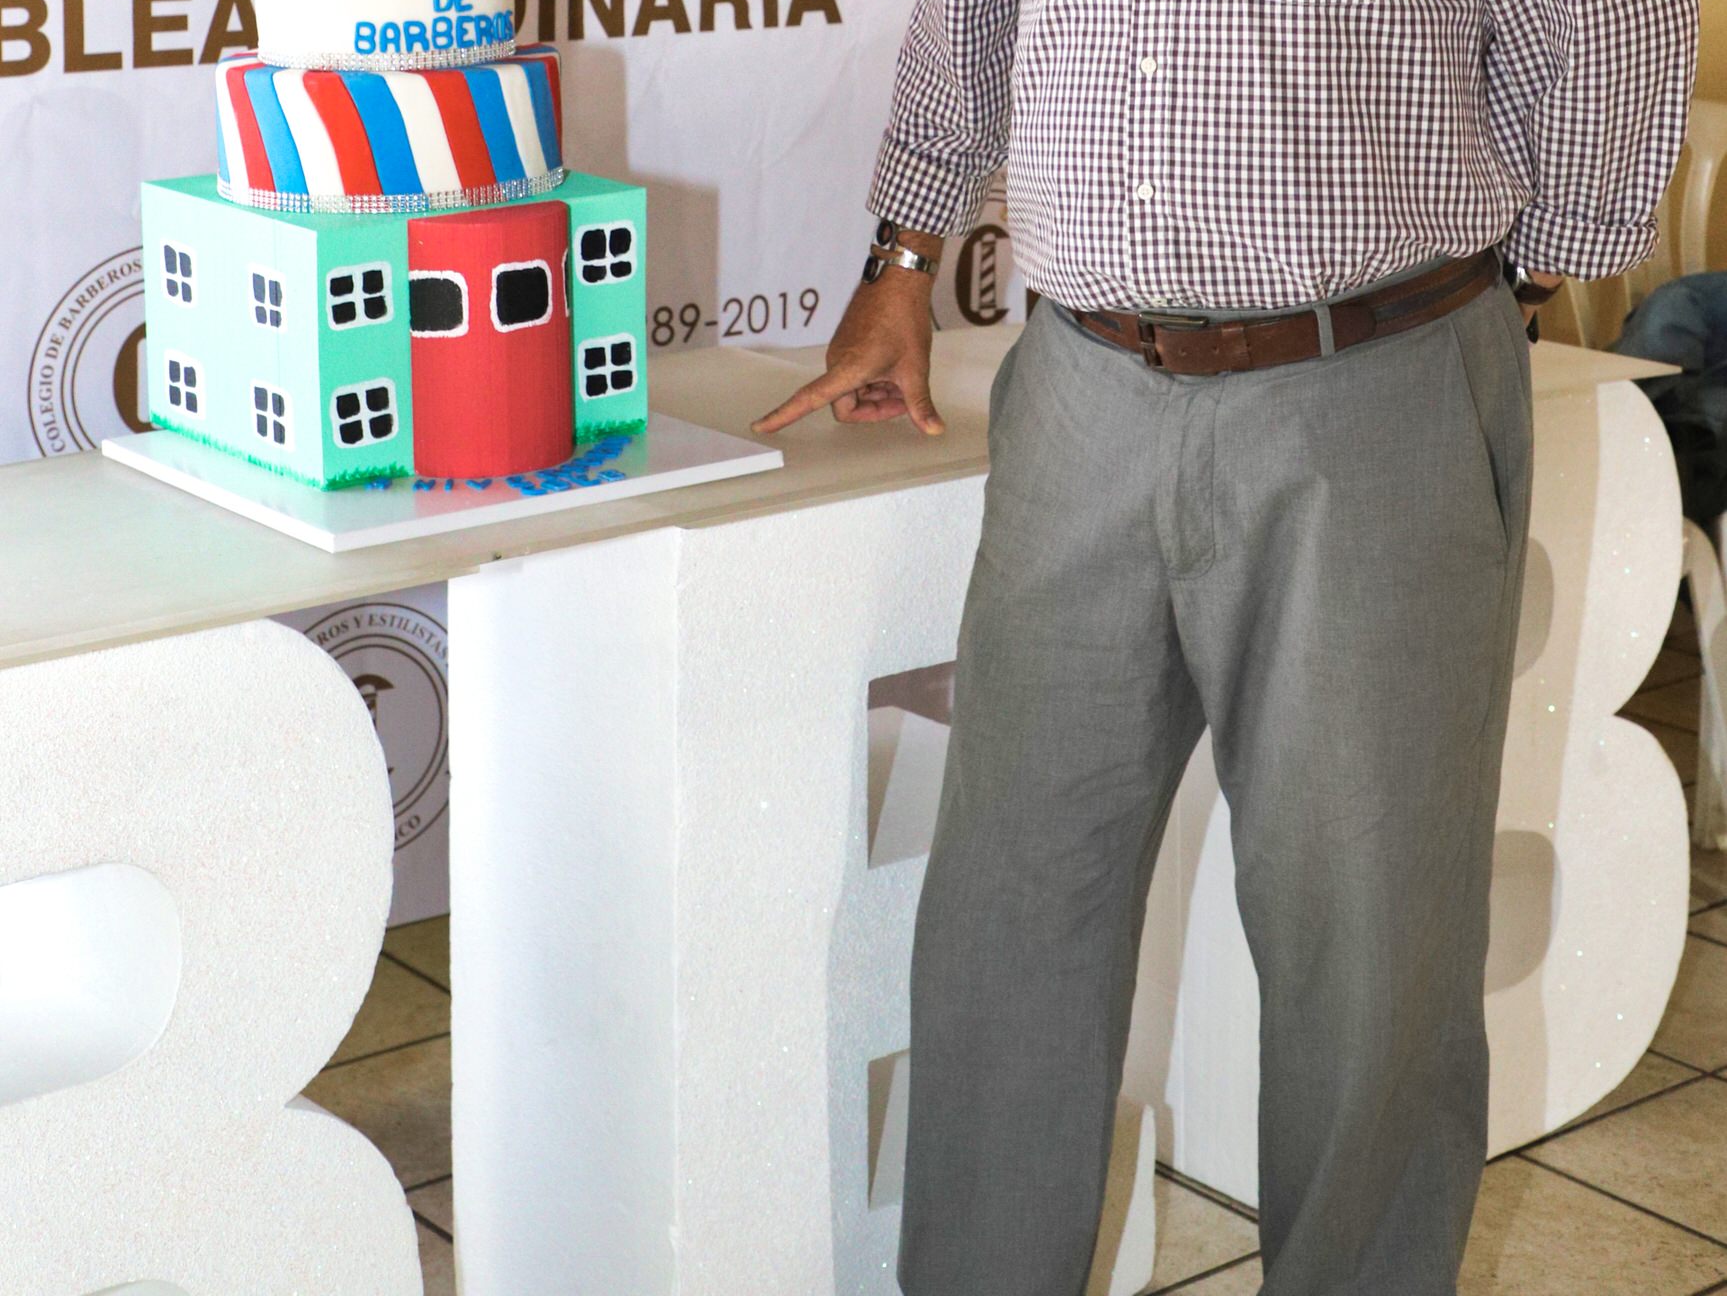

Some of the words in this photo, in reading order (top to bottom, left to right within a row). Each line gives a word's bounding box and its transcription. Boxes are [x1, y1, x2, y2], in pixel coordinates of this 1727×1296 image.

[354, 10, 514, 55] BARBEROS
[59, 257, 143, 329] BARBEROS
[47, 334, 64, 360] DE
[39, 364, 66, 452] COLEGIO
[353, 613, 365, 629] Y
